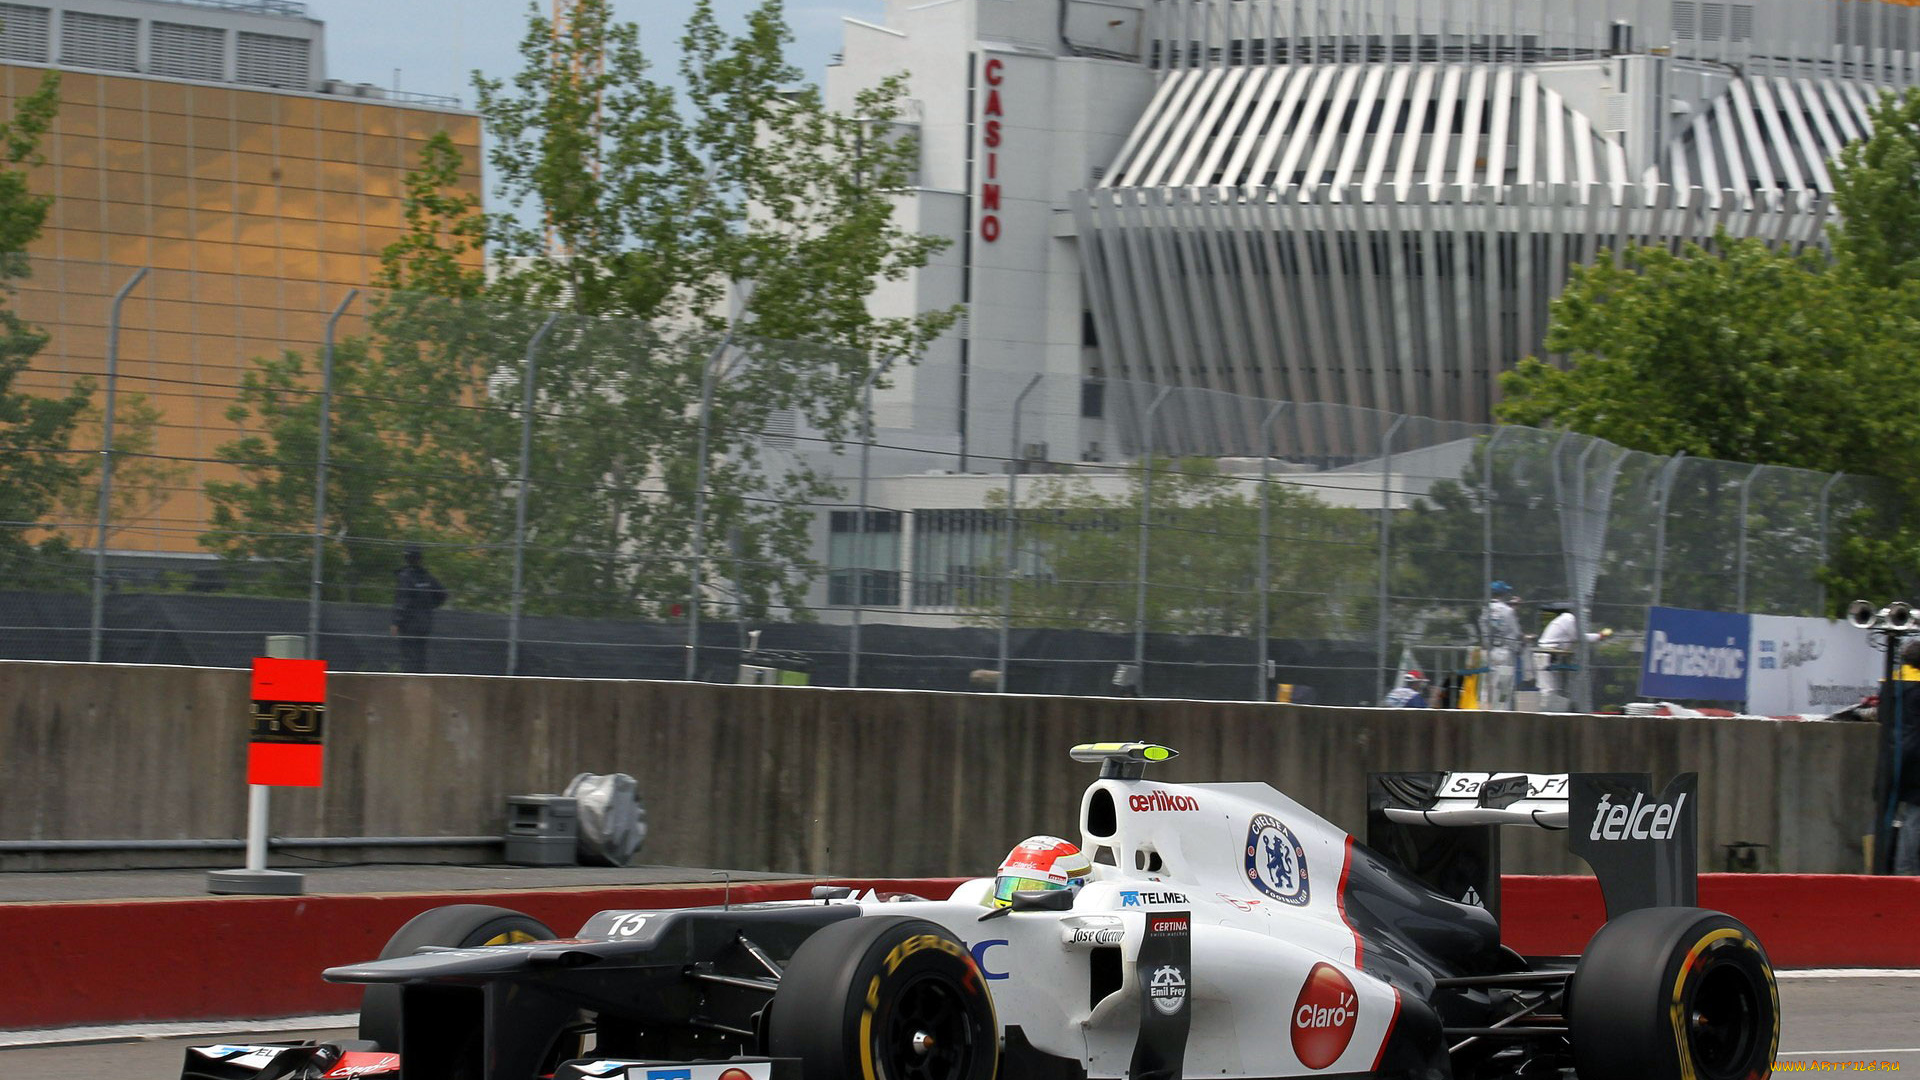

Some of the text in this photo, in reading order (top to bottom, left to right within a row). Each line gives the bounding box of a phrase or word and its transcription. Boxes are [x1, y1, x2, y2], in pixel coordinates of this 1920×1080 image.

[980, 59, 1004, 242] CASINO
[1648, 630, 1745, 679] Panasonic
[1251, 815, 1290, 836] CHELSEA
[1589, 792, 1687, 841] telcel
[1140, 892, 1190, 905] TELMEX
[607, 913, 656, 937] 15
[1069, 927, 1095, 943] Jose
[1154, 921, 1188, 932] CERTINA
[1150, 987, 1186, 997] Emil Frey
[1296, 1003, 1346, 1028] Claro
